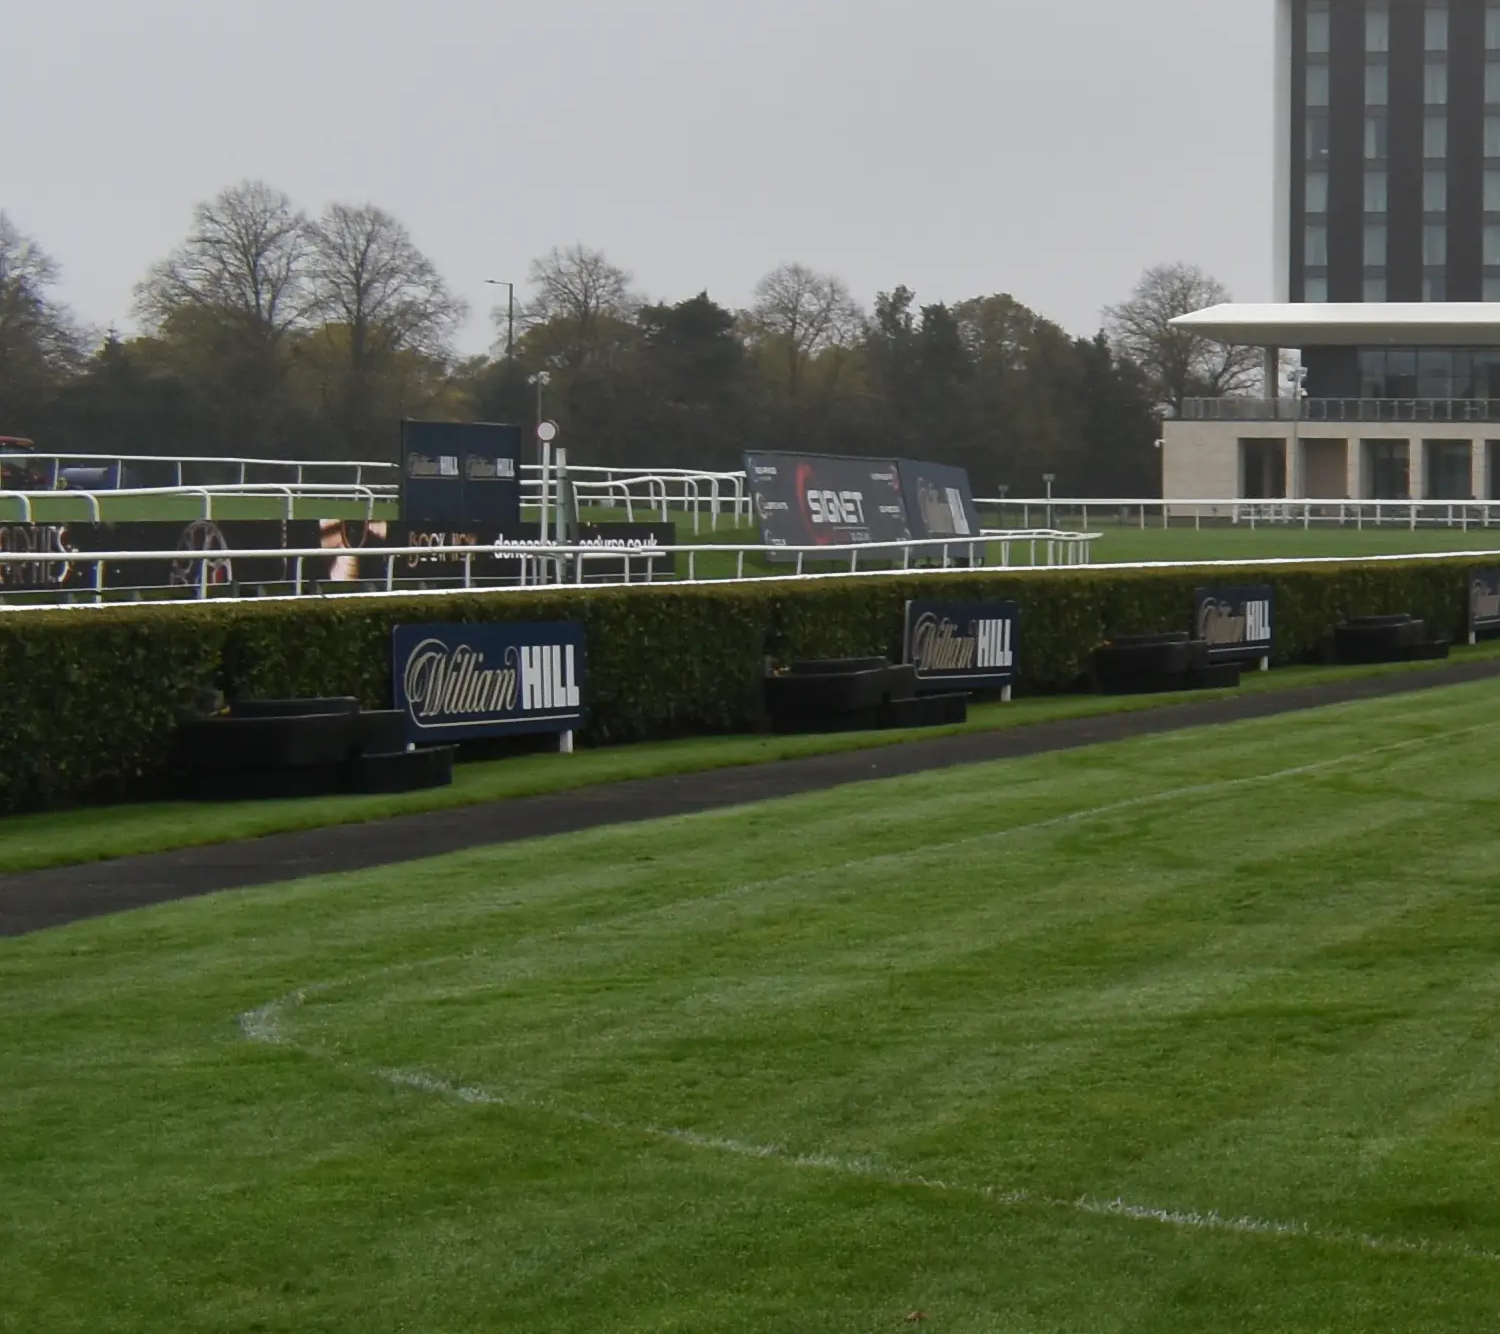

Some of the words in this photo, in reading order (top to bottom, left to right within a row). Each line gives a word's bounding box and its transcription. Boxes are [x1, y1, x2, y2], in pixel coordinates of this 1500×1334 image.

[807, 489, 865, 524] SIGNET
[913, 612, 976, 671] William
[977, 619, 1013, 667] HILL
[1246, 600, 1271, 640] HILL
[405, 638, 520, 719] William
[521, 645, 580, 710] HILL
